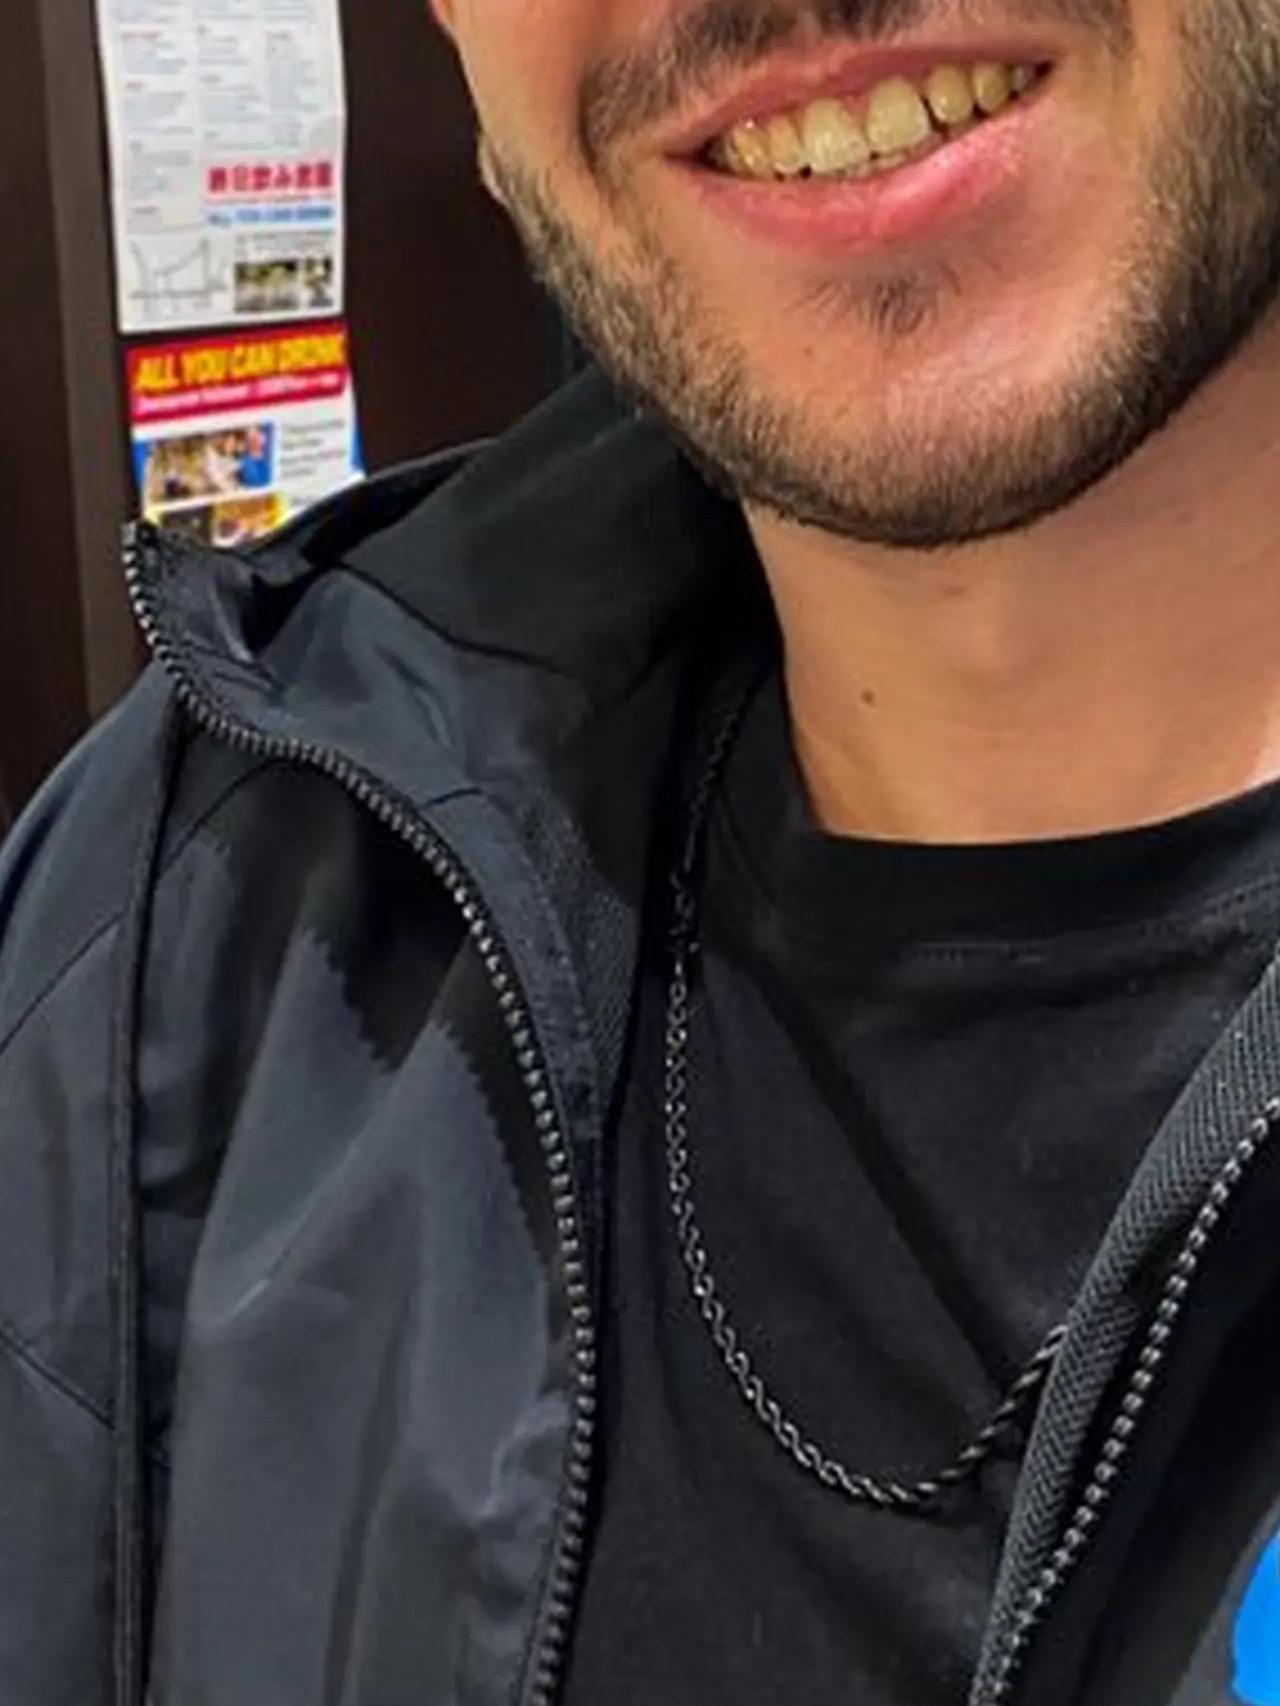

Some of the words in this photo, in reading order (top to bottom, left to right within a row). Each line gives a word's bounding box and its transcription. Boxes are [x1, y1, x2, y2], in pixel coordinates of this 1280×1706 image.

[135, 352, 180, 391] ALL
[181, 346, 228, 385] YOU
[230, 340, 276, 378] CAN
